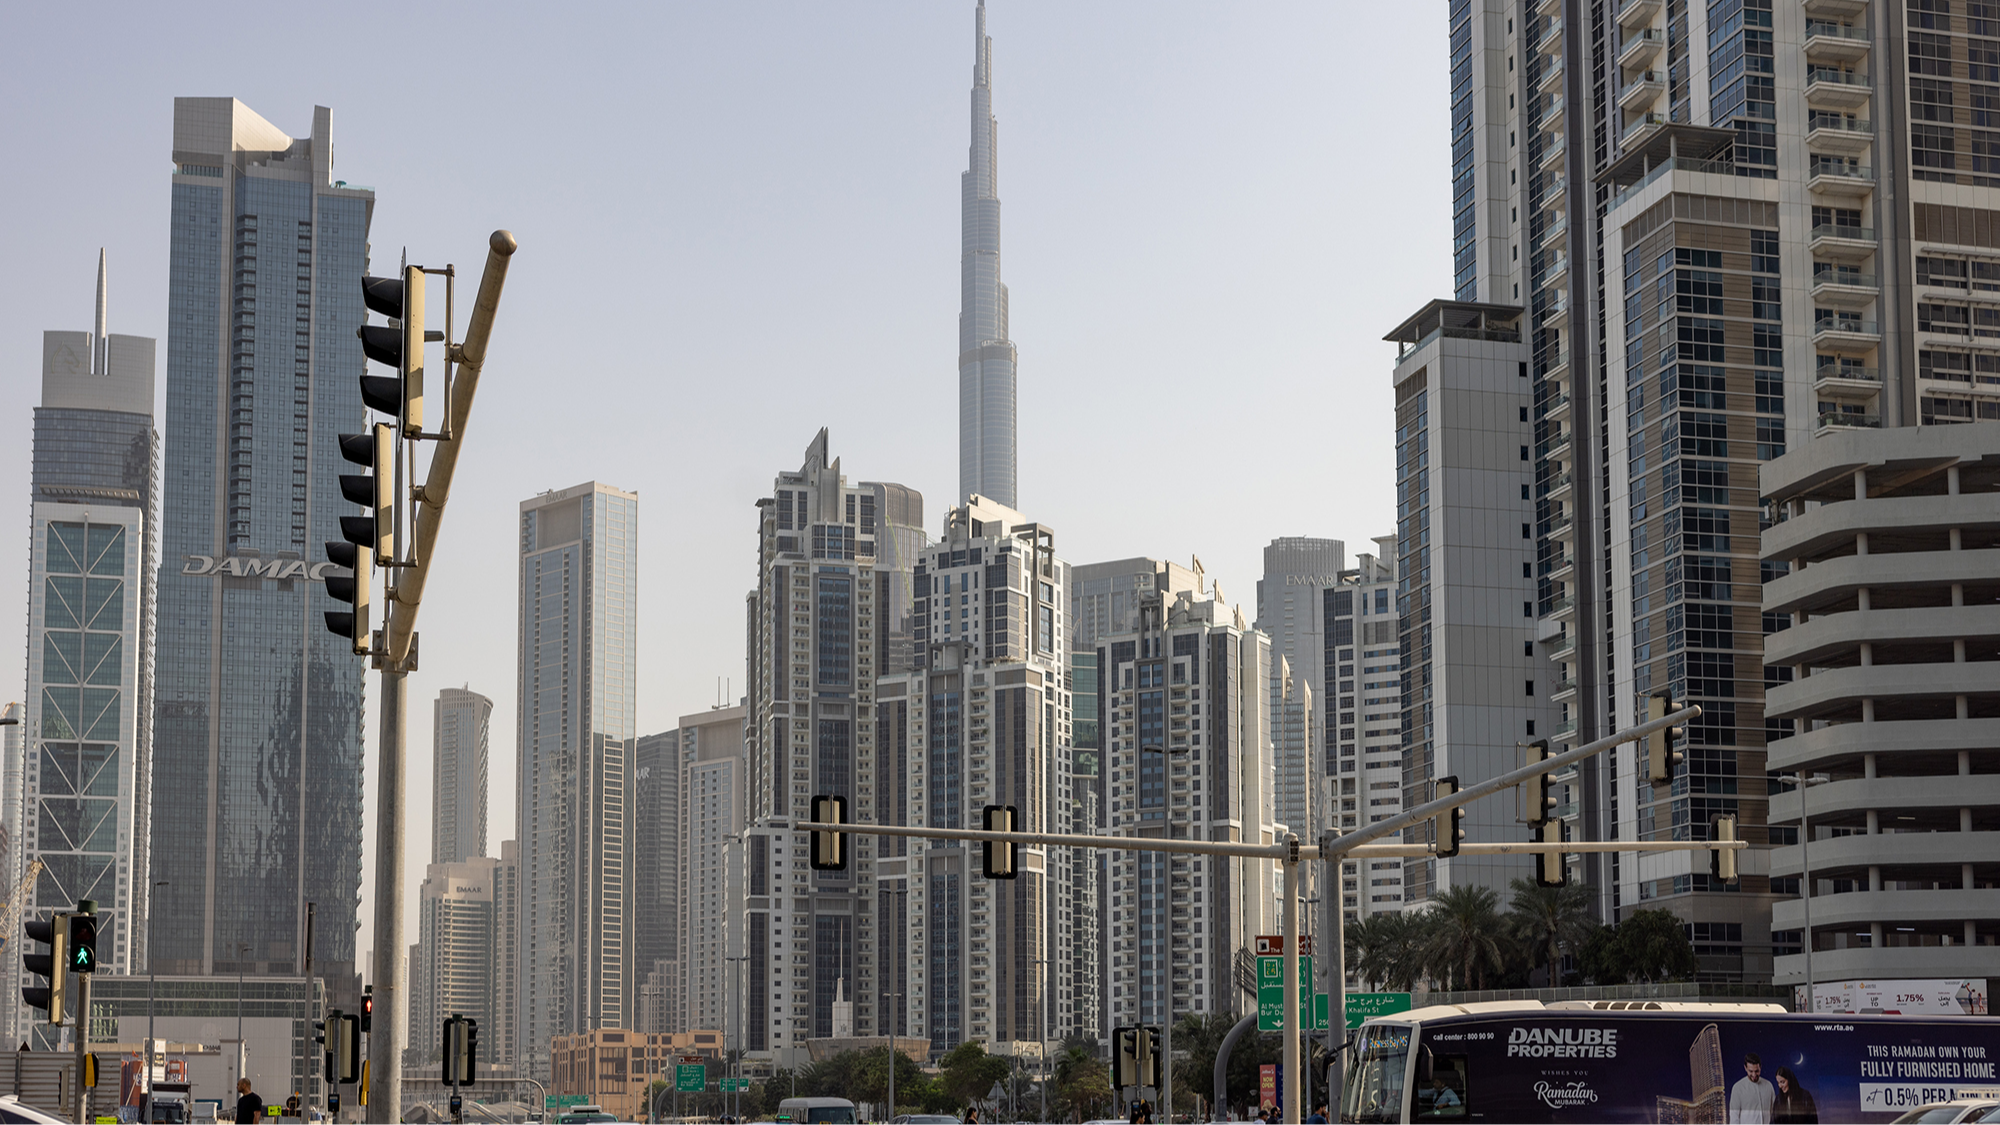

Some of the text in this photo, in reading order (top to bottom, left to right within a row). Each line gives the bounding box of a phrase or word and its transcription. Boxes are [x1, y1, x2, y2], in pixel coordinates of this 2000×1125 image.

[182, 555, 340, 581] DAMAC
[1286, 575, 1334, 586] EMAAR
[1897, 994, 1924, 1003] 1.75%
[1433, 1033, 1443, 1041] call
[1444, 1033, 1463, 1041] center
[1467, 1032, 1478, 1040] 800
[1479, 1032, 1487, 1040] 90
[1487, 1032, 1495, 1040] 90
[1508, 1027, 1618, 1045] DANUBE
[1507, 1044, 1617, 1058] PROPERTIES
[1867, 1045, 1986, 1059] THIS RAMADAN OWN YOUR
[1860, 1061, 1997, 1079] FULLY FURNISHED HOME
[1533, 1080, 1599, 1109] Ramadan
[1866, 1088, 1884, 1105] at
[1885, 1088, 1919, 1106] 0.5%
